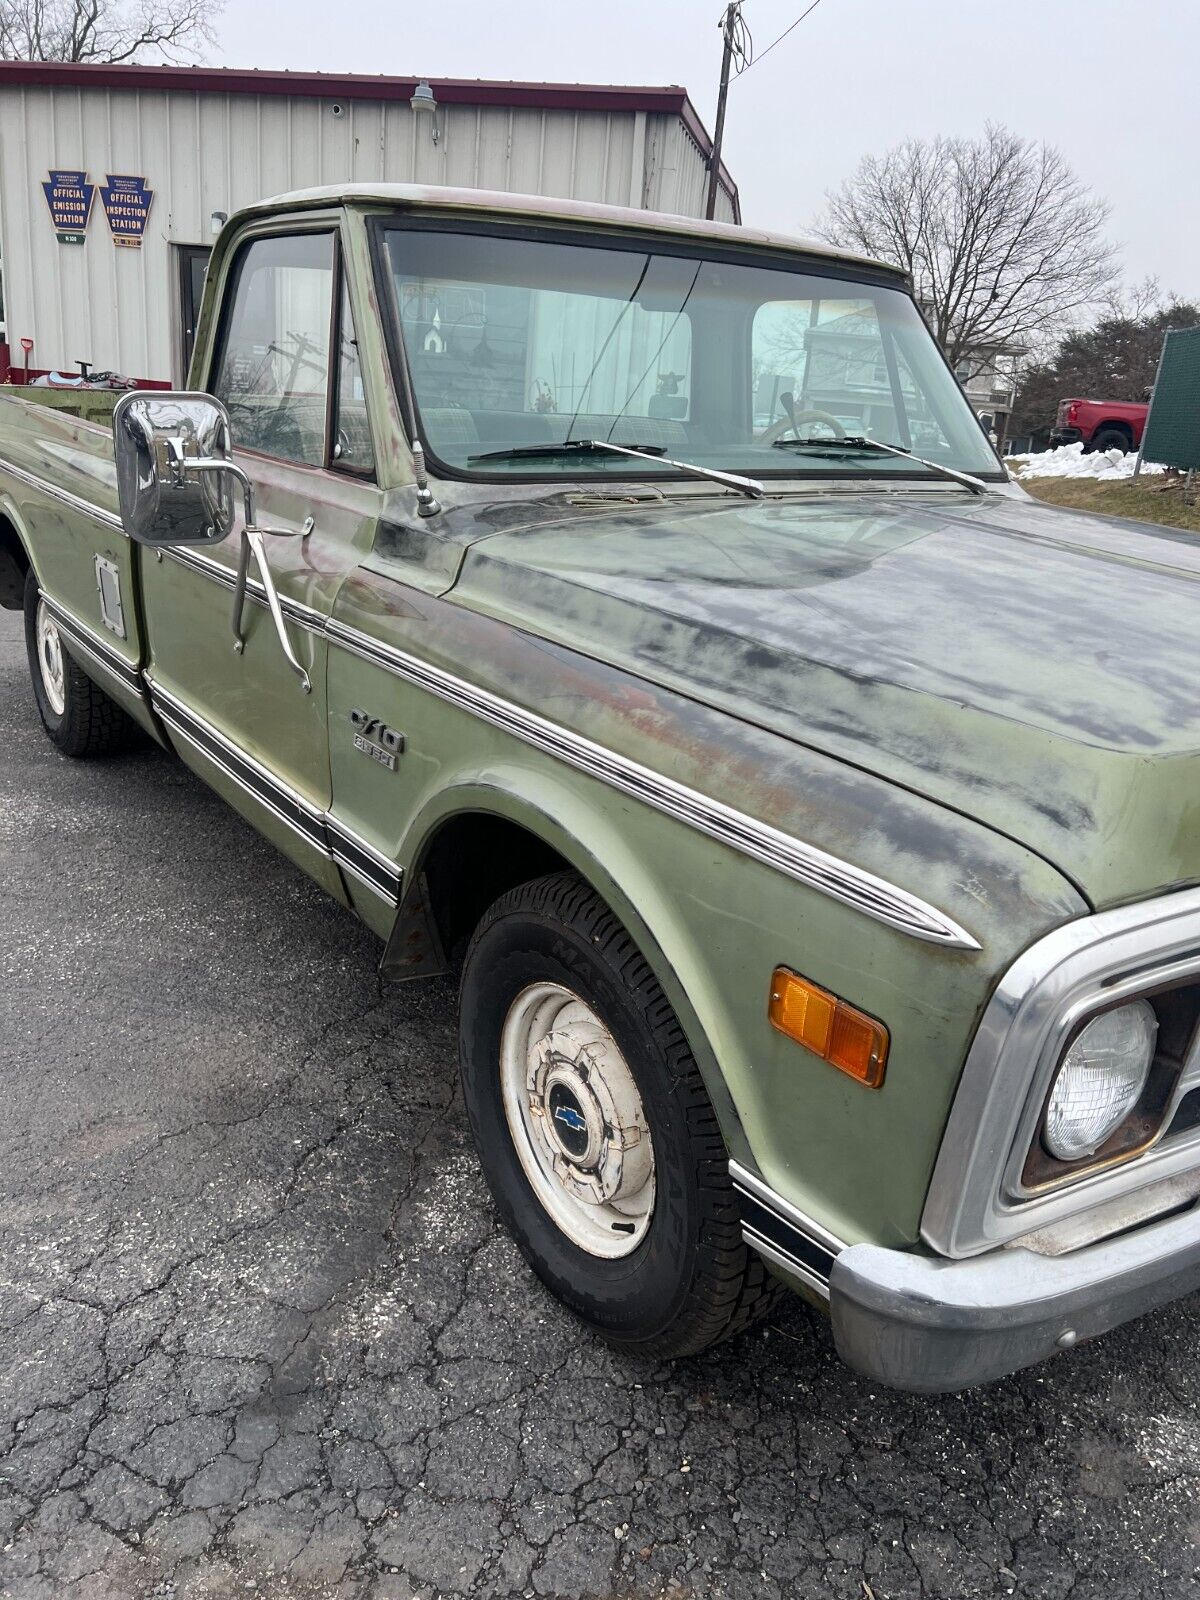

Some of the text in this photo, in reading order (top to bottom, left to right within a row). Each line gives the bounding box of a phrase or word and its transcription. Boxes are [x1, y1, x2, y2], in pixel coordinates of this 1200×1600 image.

[53, 189, 85, 199] OFFICIAL
[110, 194, 143, 204] OFFICIAL
[53, 202, 86, 211] EMISSION
[106, 206, 147, 217] INSPECTION
[54, 214, 84, 224] STATION
[111, 219, 142, 229] STATION
